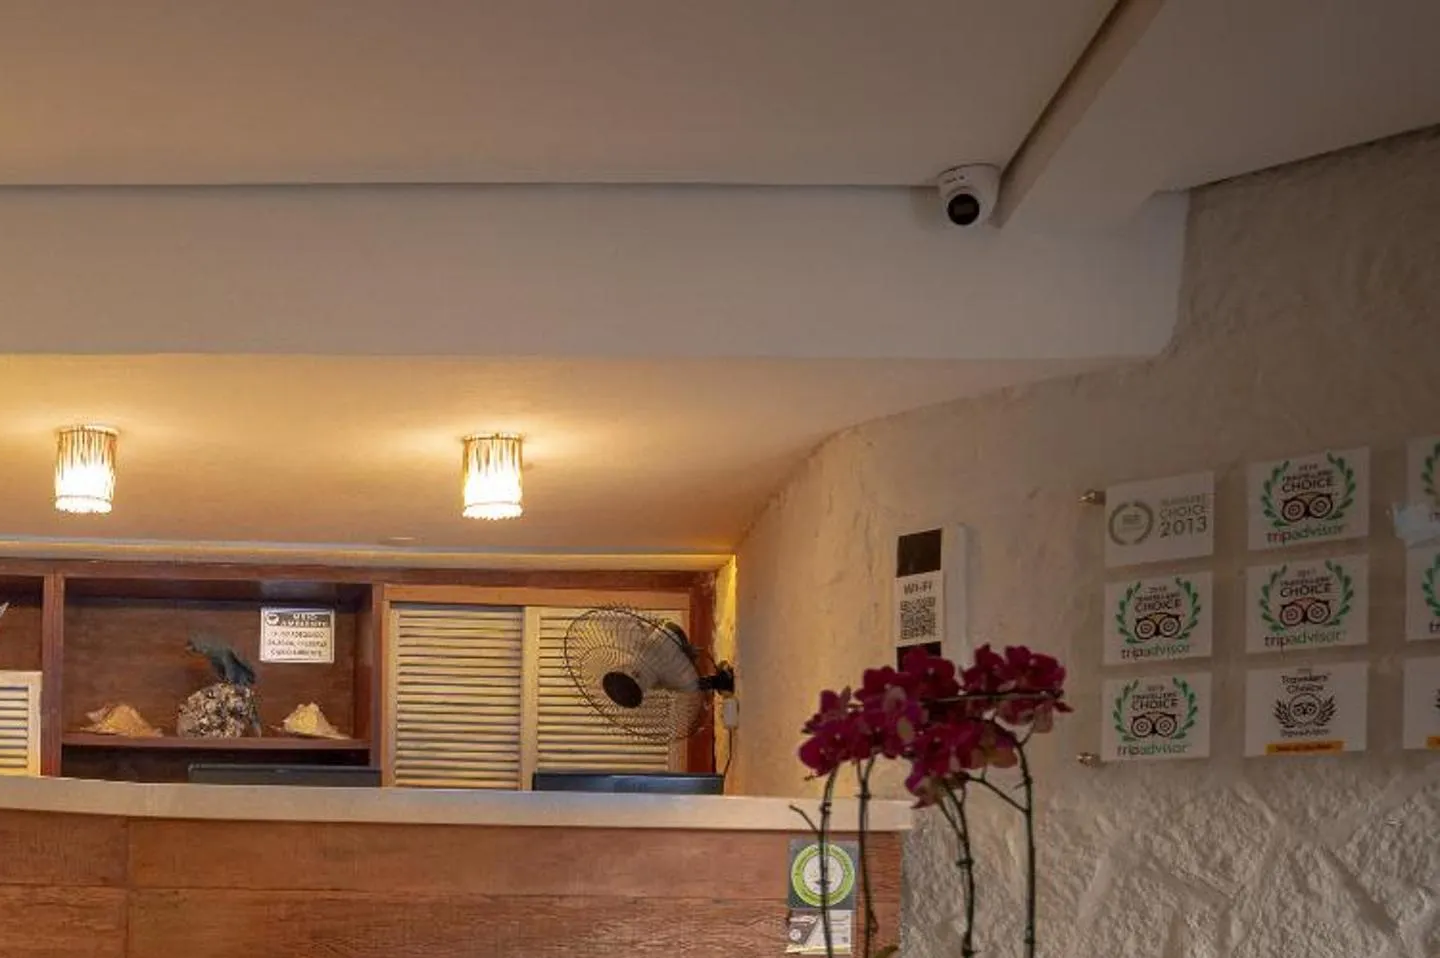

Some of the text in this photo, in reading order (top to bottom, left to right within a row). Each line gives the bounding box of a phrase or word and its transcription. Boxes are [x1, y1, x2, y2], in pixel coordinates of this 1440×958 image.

[1282, 476, 1334, 493] CHOICE
[1160, 515, 1207, 538] 2013
[1280, 583, 1332, 598] CHOICE
